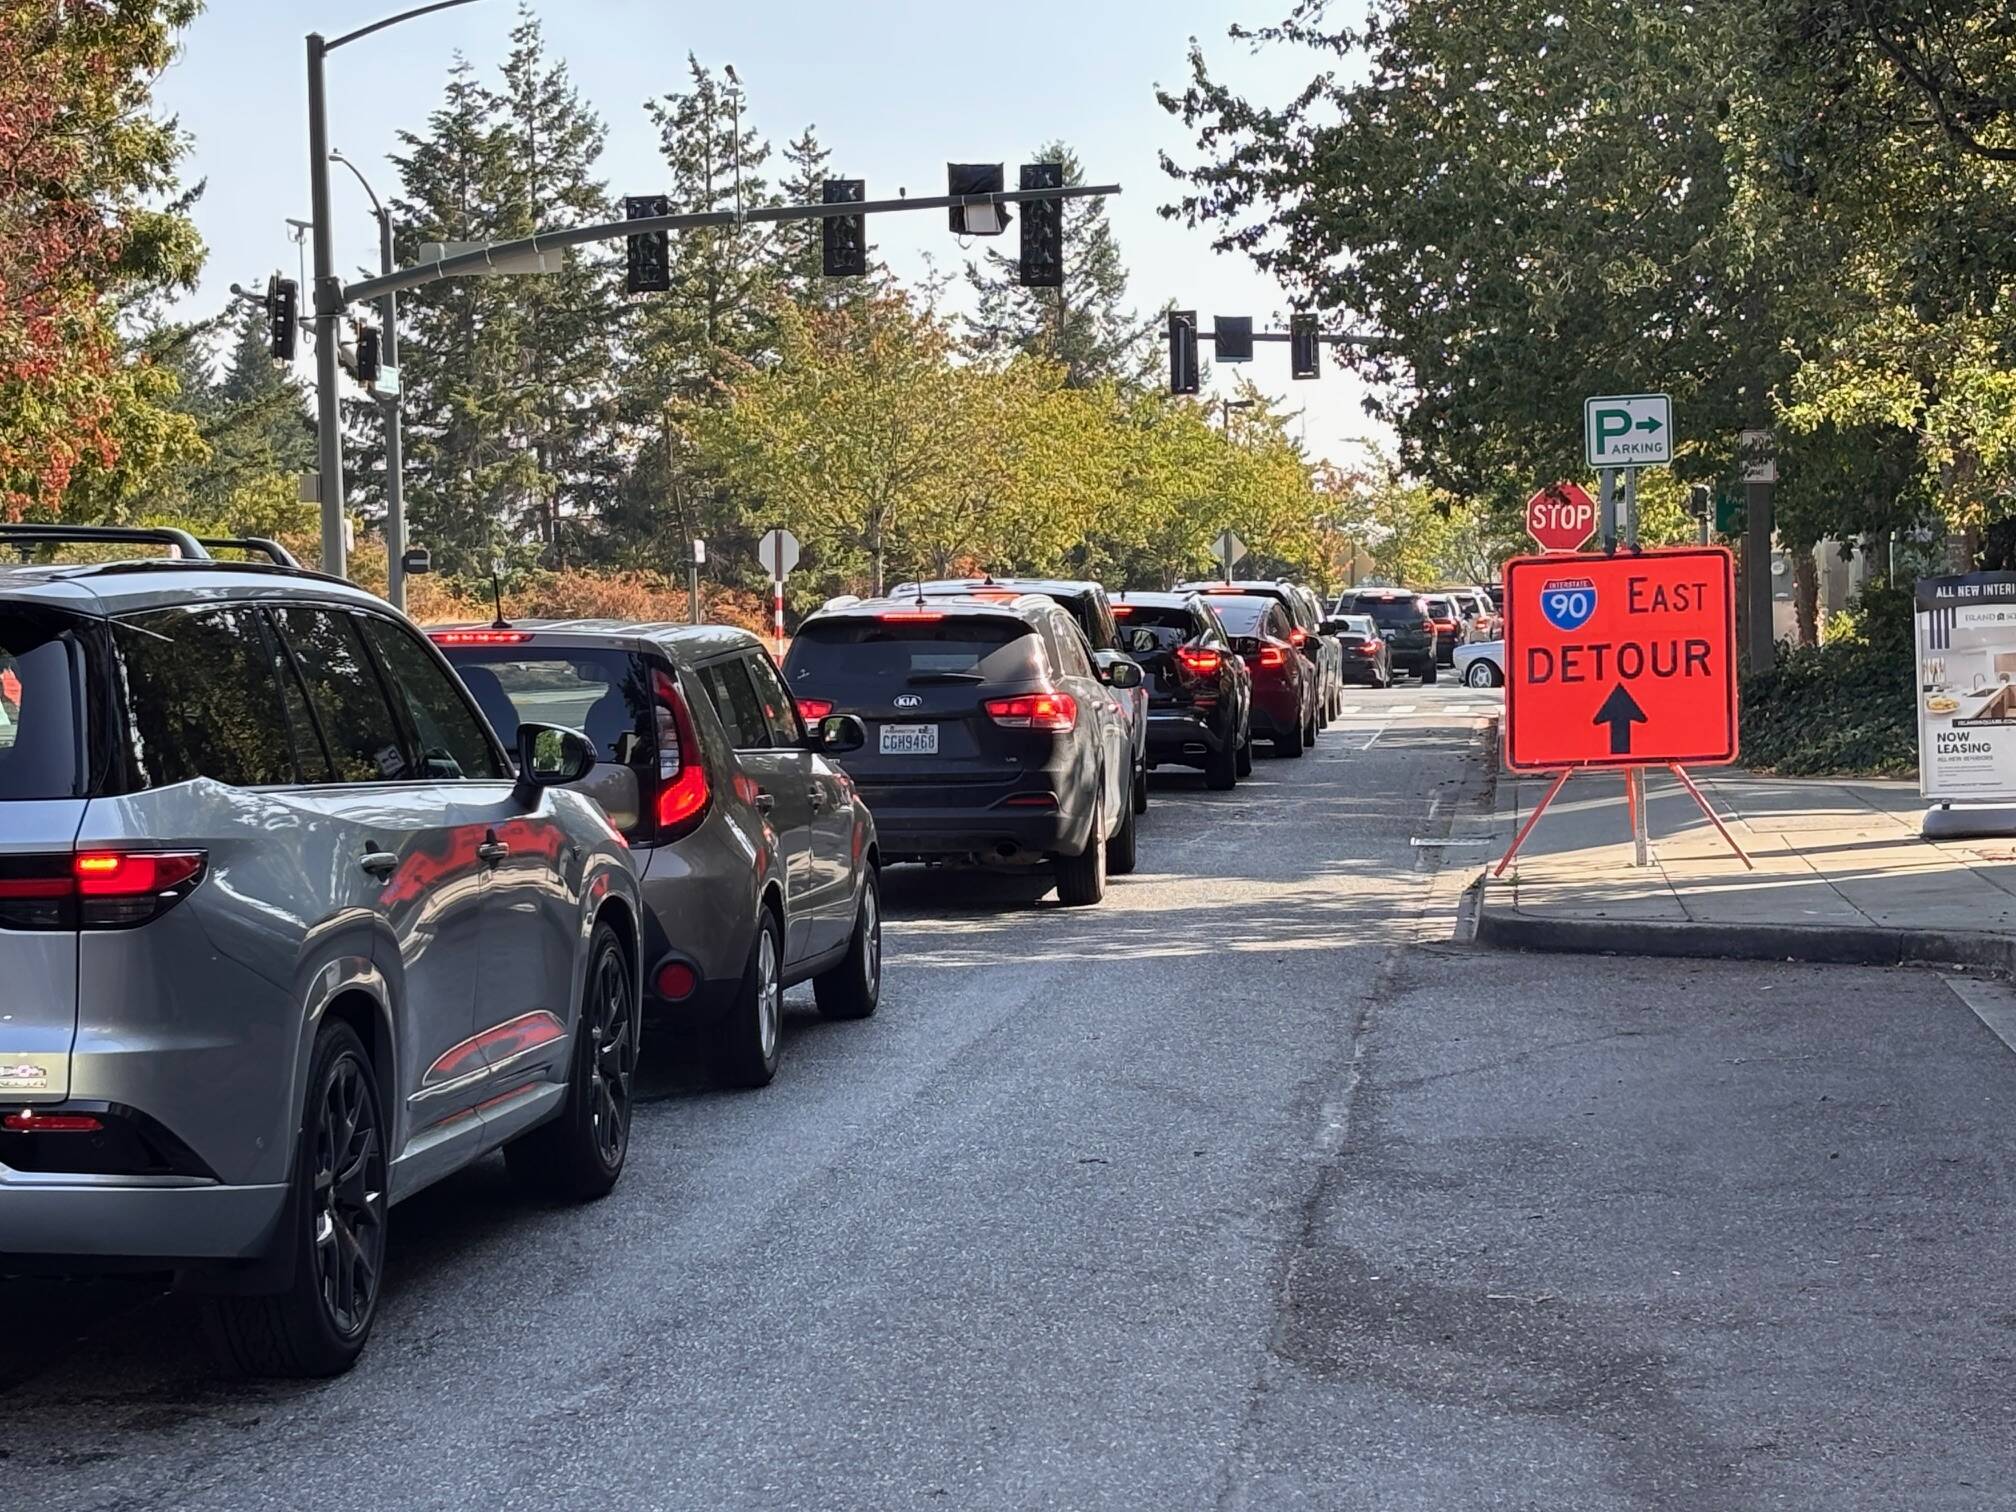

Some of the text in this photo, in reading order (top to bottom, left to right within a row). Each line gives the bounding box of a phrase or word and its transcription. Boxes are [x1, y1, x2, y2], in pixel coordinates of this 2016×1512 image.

[1532, 504, 1592, 530] STOP
[1549, 581, 1588, 589] INTERSTATE
[1550, 577, 1707, 618] 90 EAST
[1936, 586, 1954, 598] ALL
[1957, 585, 1979, 597] NEW
[1528, 639, 1711, 684] DETOUR
[898, 697, 918, 706] KIA
[1937, 731, 1970, 742] NOW
[1937, 742, 1992, 754] LEASING
